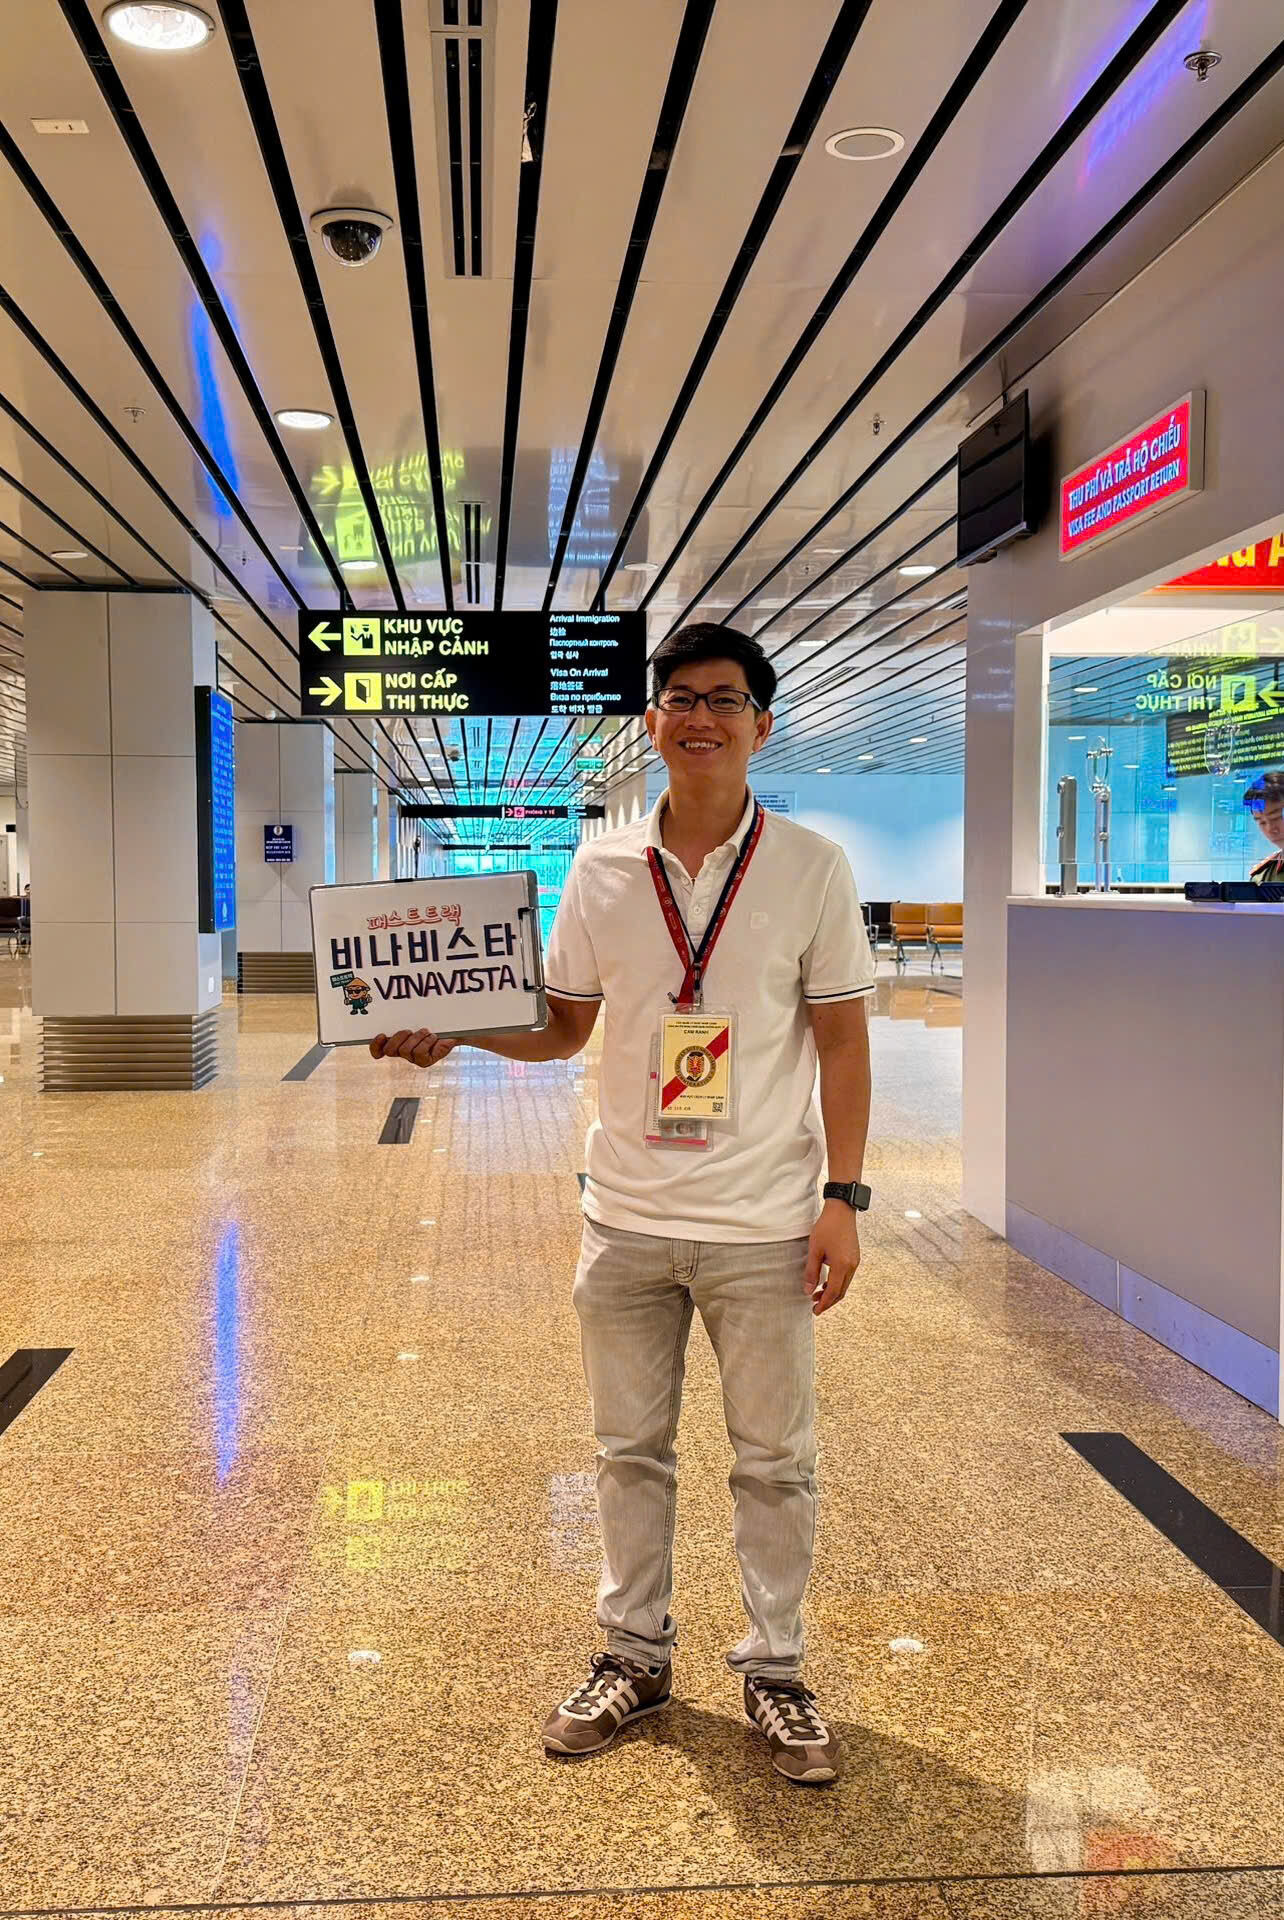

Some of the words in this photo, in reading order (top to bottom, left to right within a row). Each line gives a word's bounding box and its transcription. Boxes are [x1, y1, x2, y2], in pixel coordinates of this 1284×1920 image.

[1069, 485, 1085, 511] THU
[1085, 469, 1101, 502] PHÍ
[1100, 464, 1114, 492] VÀ
[1115, 449, 1131, 483] TRẢ
[1134, 440, 1148, 473] HỘ
[1150, 415, 1181, 461] CHIẾU
[1068, 518, 1084, 537] VISA
[1084, 512, 1096, 530] FEE
[1095, 500, 1113, 523] AND
[1113, 478, 1150, 513] PASSPORT
[1150, 459, 1181, 492] RETURN
[384, 618, 422, 634] KHU
[426, 617, 464, 637] VỰC
[550, 614, 575, 623] Arrival
[575, 614, 620, 624] Immigration
[384, 637, 434, 658] NHẬP
[439, 635, 489, 655] CẢNH
[385, 672, 416, 689] NƠI
[420, 668, 458, 689] CẤP
[550, 668, 568, 677] Visa
[569, 668, 581, 677] On
[583, 668, 608, 677] Arrival
[386, 694, 416, 712] THỊ
[419, 693, 469, 712] THỰC
[569, 704, 585, 714] 비자
[367, 904, 462, 929] 패스트트랙
[330, 922, 517, 970] 비나비스타
[373, 964, 517, 1000] VINAVISTA
